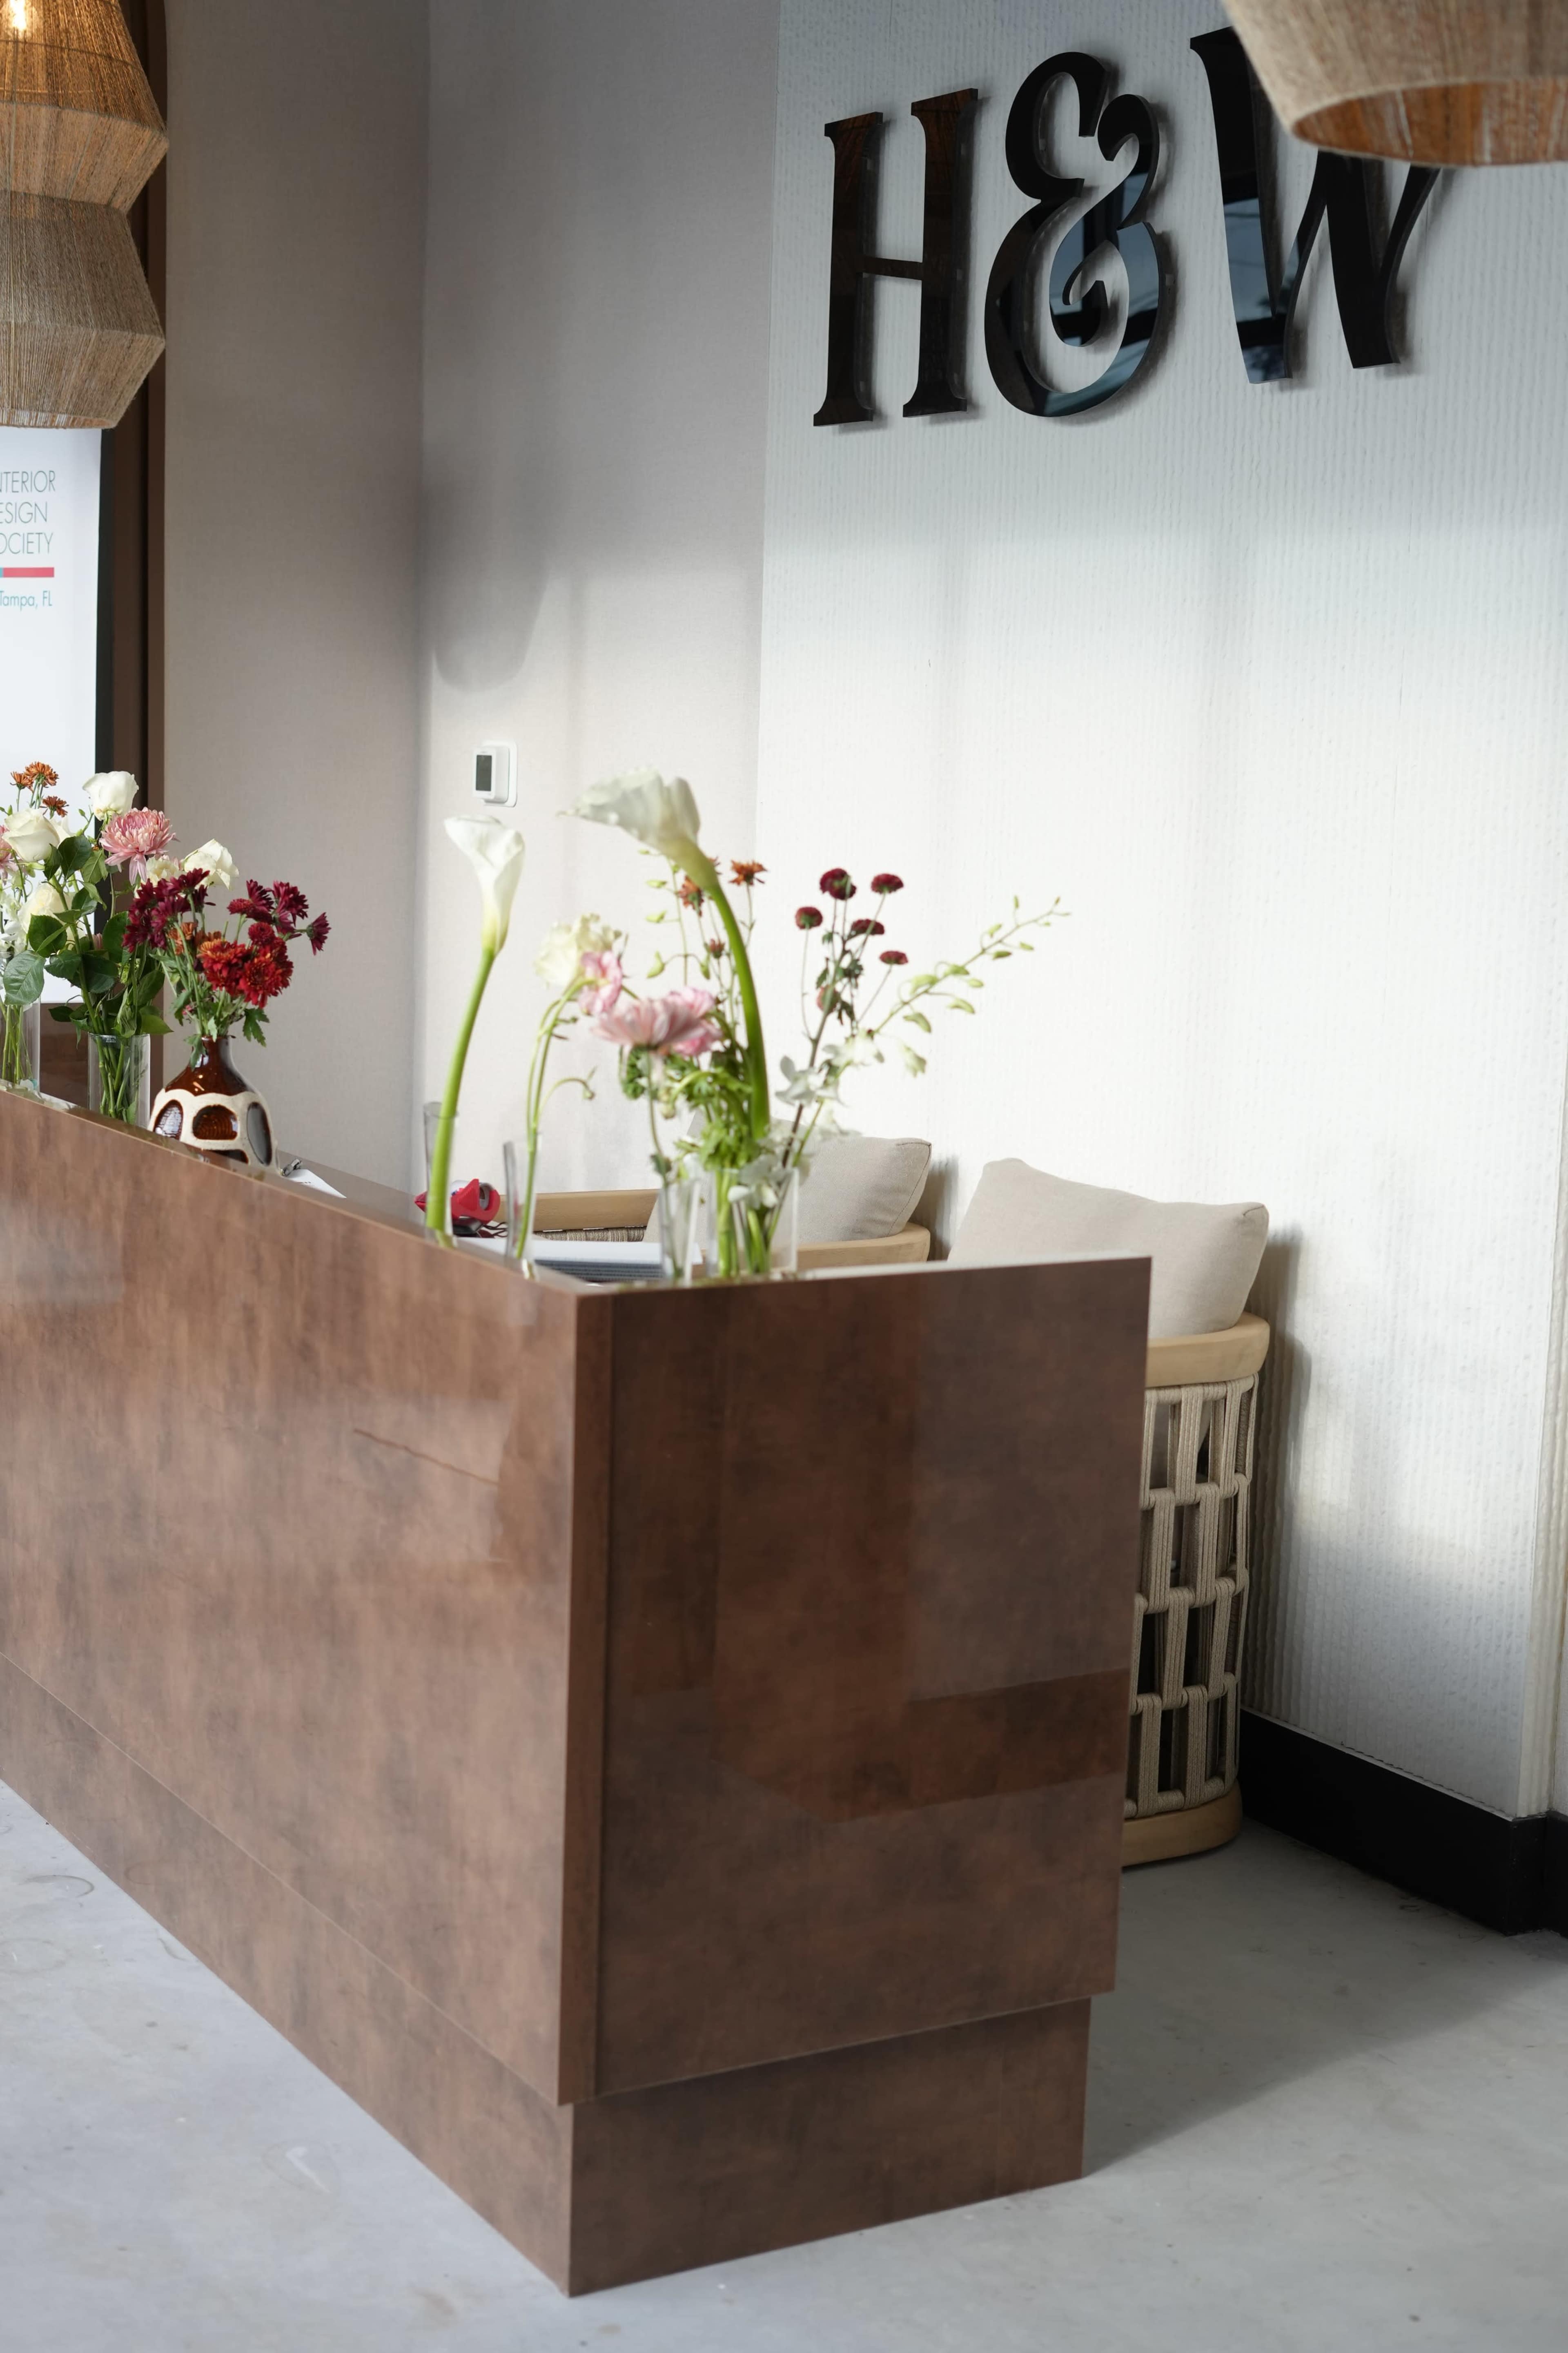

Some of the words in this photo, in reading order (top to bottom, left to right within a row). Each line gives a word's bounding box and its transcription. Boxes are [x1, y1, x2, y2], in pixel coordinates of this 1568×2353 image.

[813, 26, 1442, 426] H&W
[0, 471, 56, 493] TERIOR
[42, 590, 53, 607] FL
